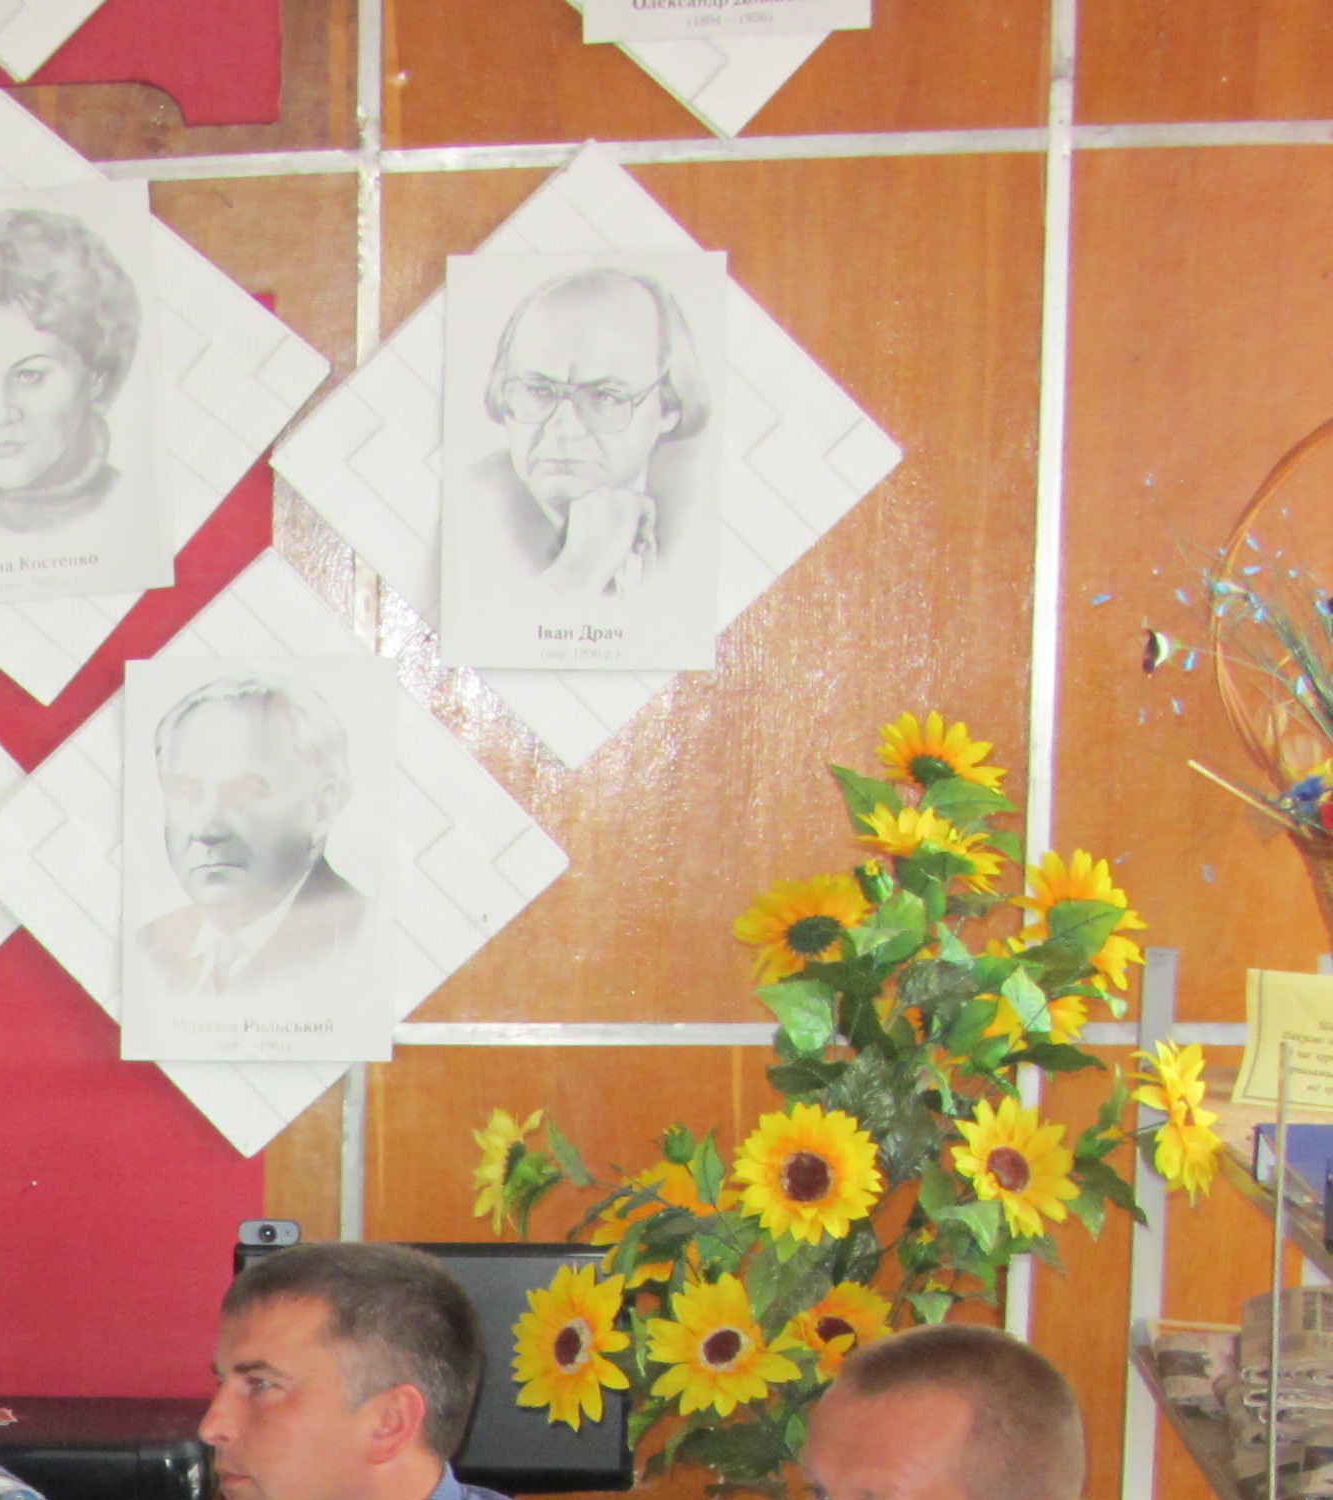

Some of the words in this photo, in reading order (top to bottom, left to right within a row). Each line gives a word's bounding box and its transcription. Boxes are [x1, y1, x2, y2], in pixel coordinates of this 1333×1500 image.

[20, 553, 99, 572] Костенко
[537, 624, 574, 640] Іван
[578, 624, 623, 643] Драч
